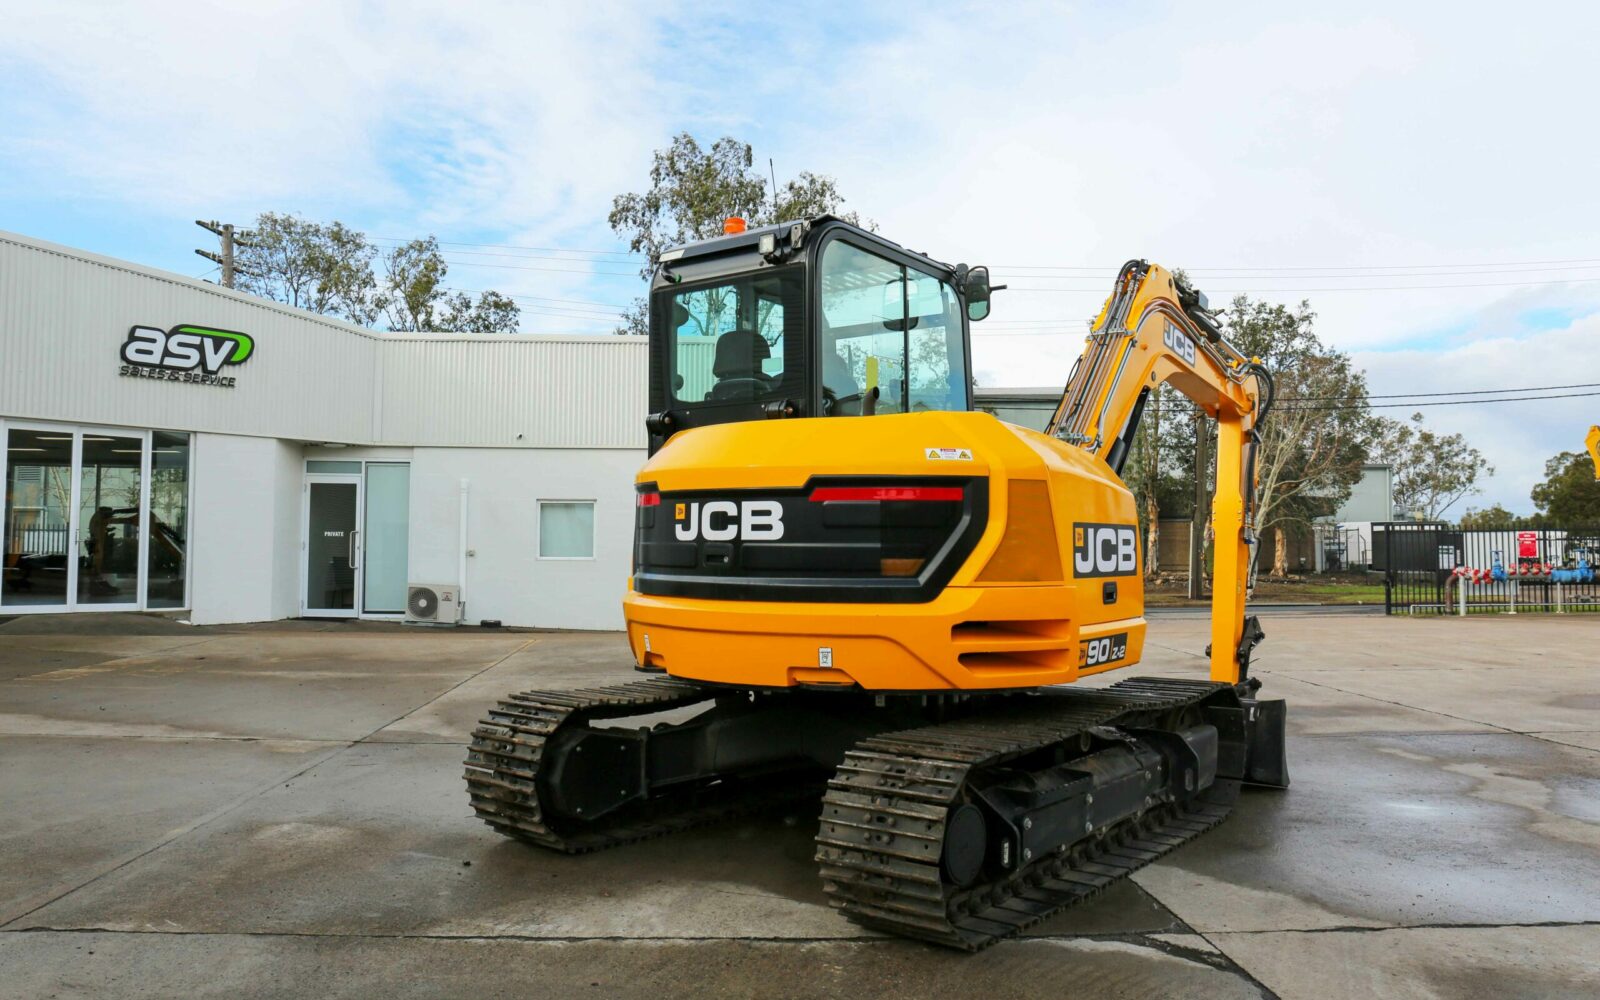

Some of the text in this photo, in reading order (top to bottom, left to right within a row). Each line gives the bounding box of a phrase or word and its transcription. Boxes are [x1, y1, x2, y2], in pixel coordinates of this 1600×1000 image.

[1164, 323, 1195, 364] JCB
[167, 370, 180, 381] &
[183, 372, 236, 387] SERVICE
[675, 501, 784, 541] JCB
[1075, 527, 1136, 573] JCB
[1087, 638, 1110, 665] 90
